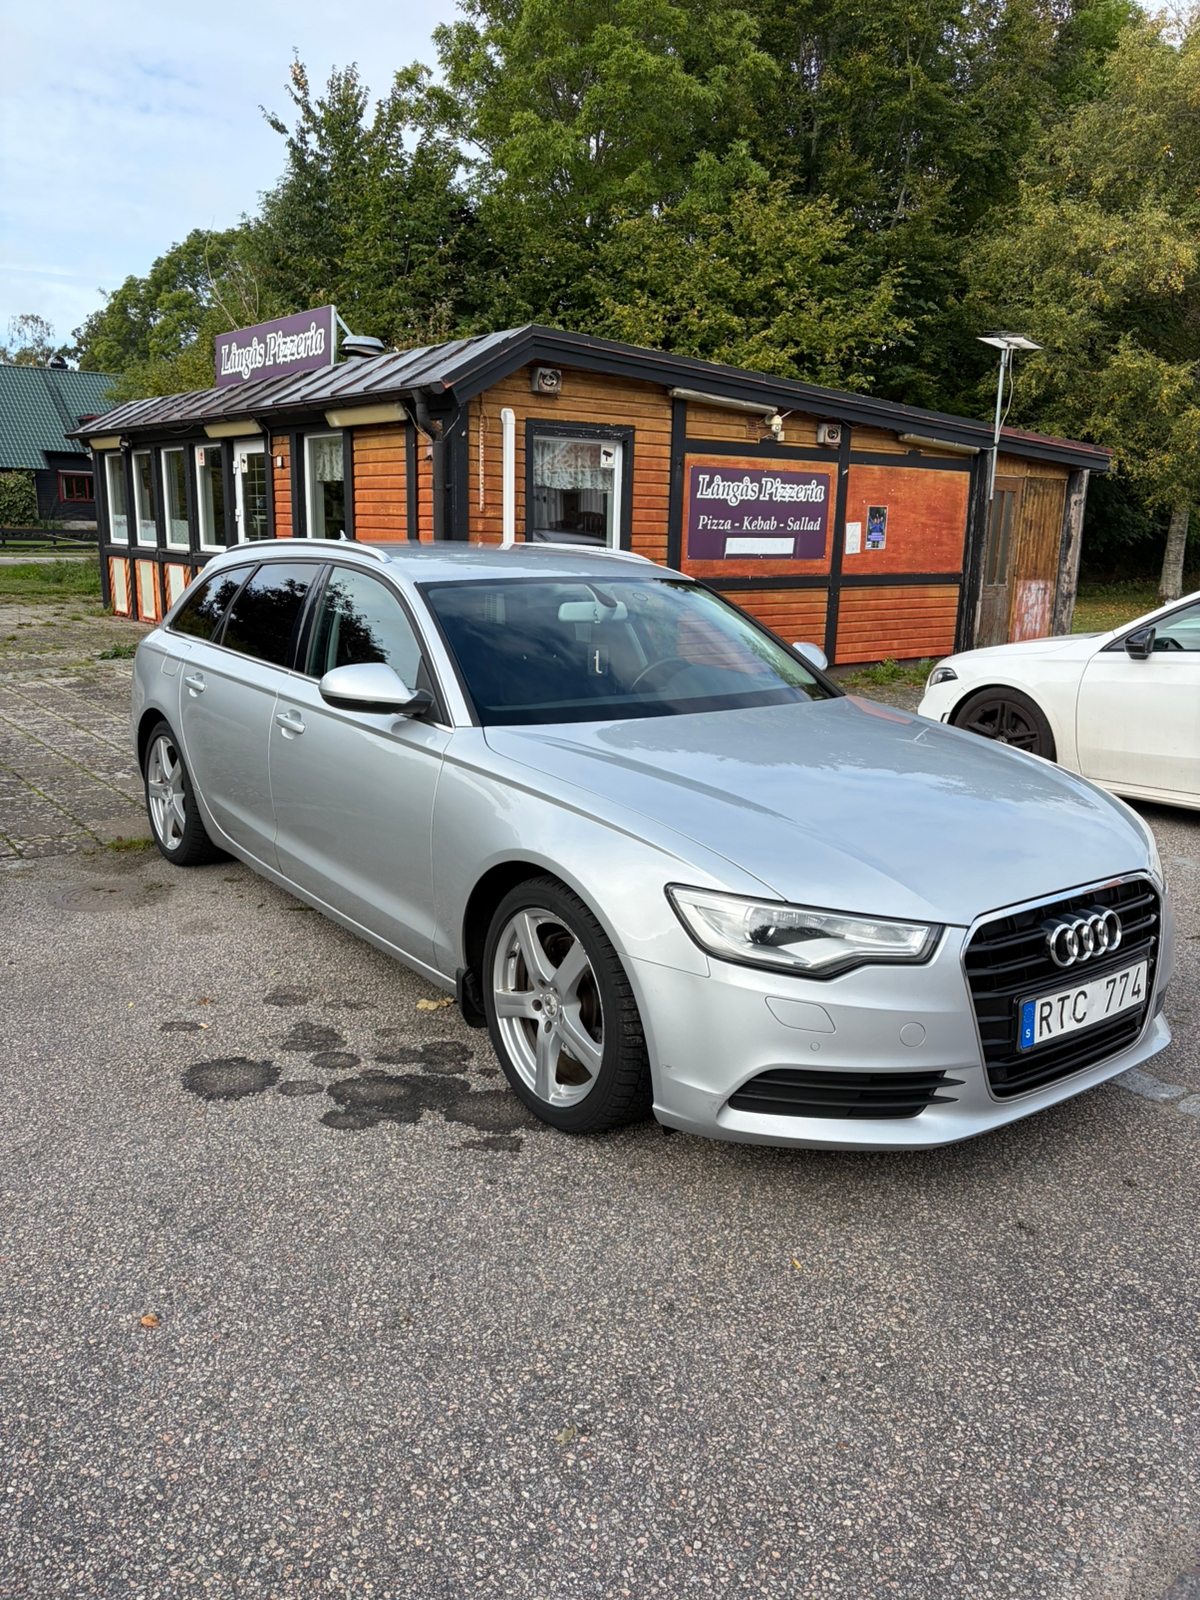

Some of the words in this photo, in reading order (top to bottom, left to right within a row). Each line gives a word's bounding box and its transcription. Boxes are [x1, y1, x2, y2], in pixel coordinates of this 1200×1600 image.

[221, 337, 265, 379] Långås
[266, 321, 325, 366] Pizzeria
[696, 474, 759, 506] Långås
[760, 477, 825, 502] Pizzeria
[697, 515, 731, 530] Pizza
[742, 516, 777, 531] Kebab
[787, 517, 821, 531] Sallad
[1025, 1029, 1031, 1039] S
[1039, 990, 1088, 1037] RTC
[1105, 967, 1141, 1013] 774
